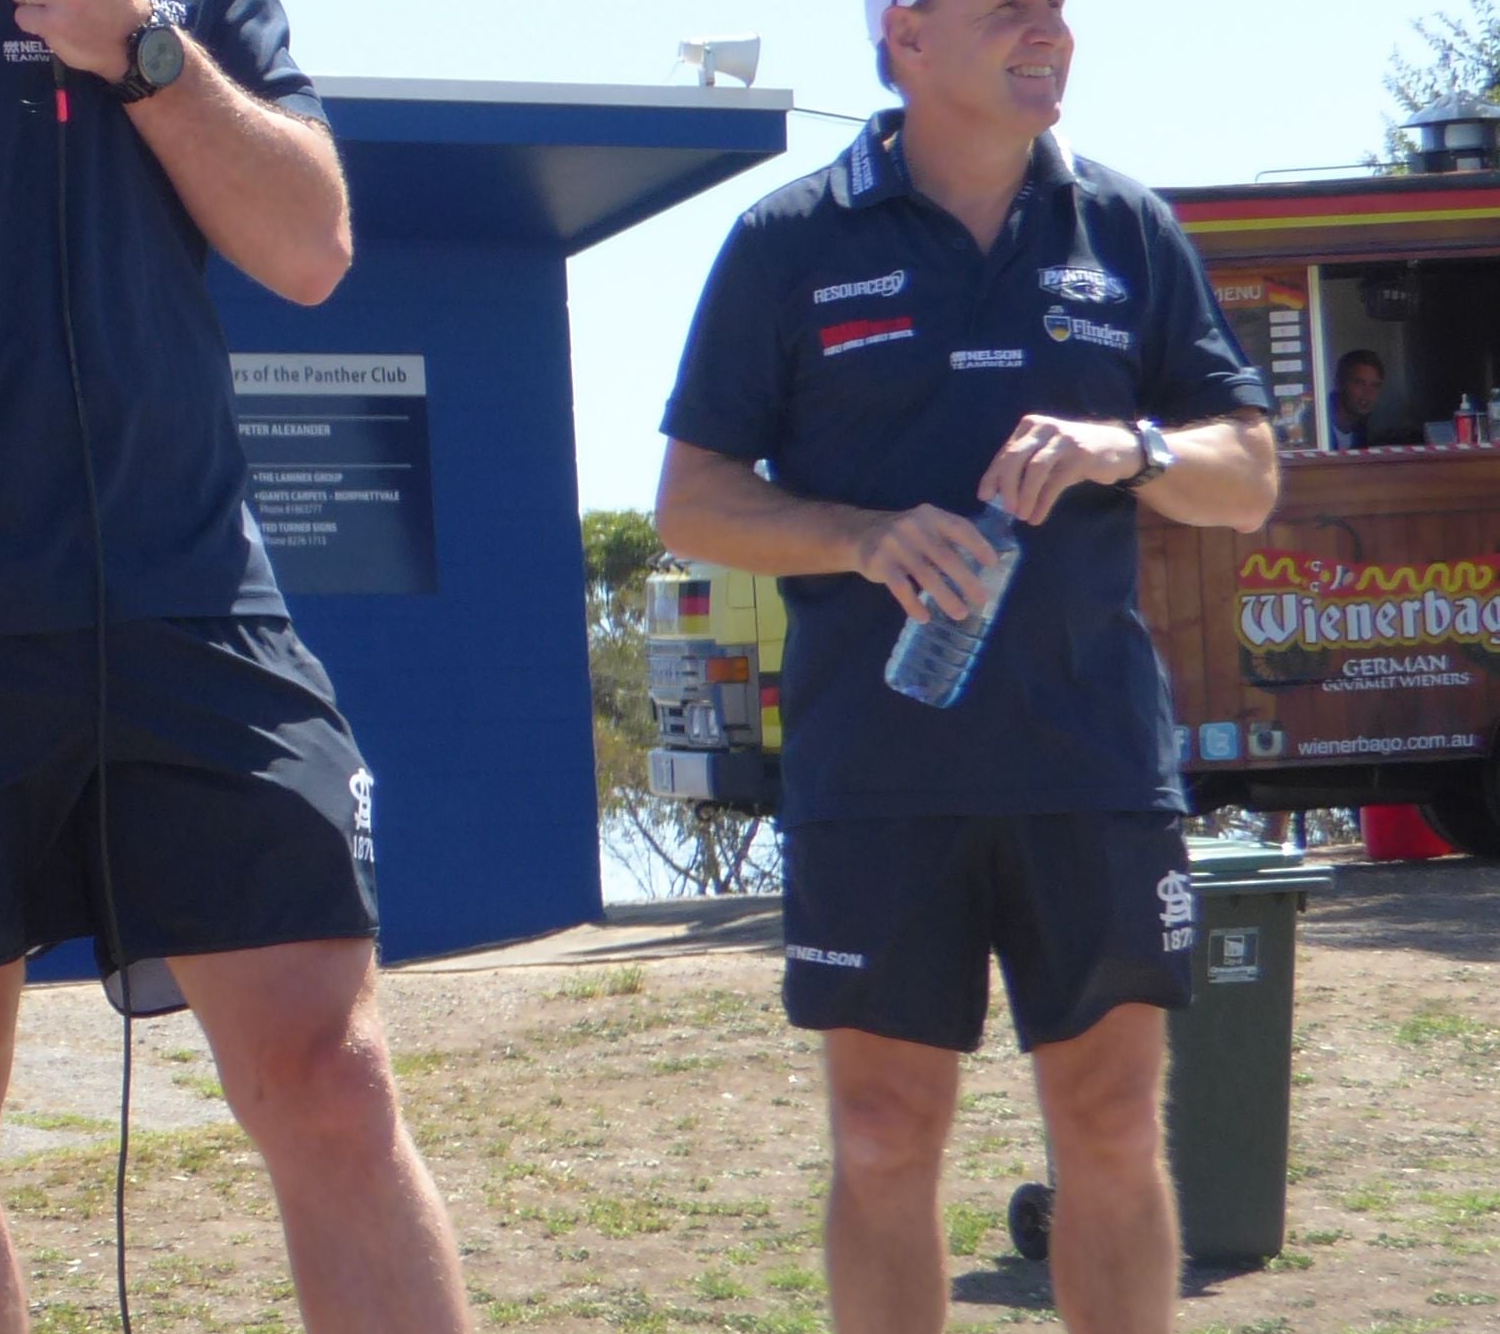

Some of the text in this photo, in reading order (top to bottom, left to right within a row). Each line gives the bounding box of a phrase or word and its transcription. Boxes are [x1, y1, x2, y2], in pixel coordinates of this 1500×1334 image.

[253, 365, 269, 382] of
[274, 365, 300, 382] the
[304, 366, 367, 383] Panther
[372, 366, 408, 383] Club
[238, 424, 331, 436] PETER ALEXANDER
[1342, 654, 1446, 677] GERMAN
[1400, 672, 1470, 688] WIENERS
[1298, 734, 1474, 755] wienerbago.com.au
[1162, 927, 1193, 952] 187
[795, 945, 862, 968] NELSON
